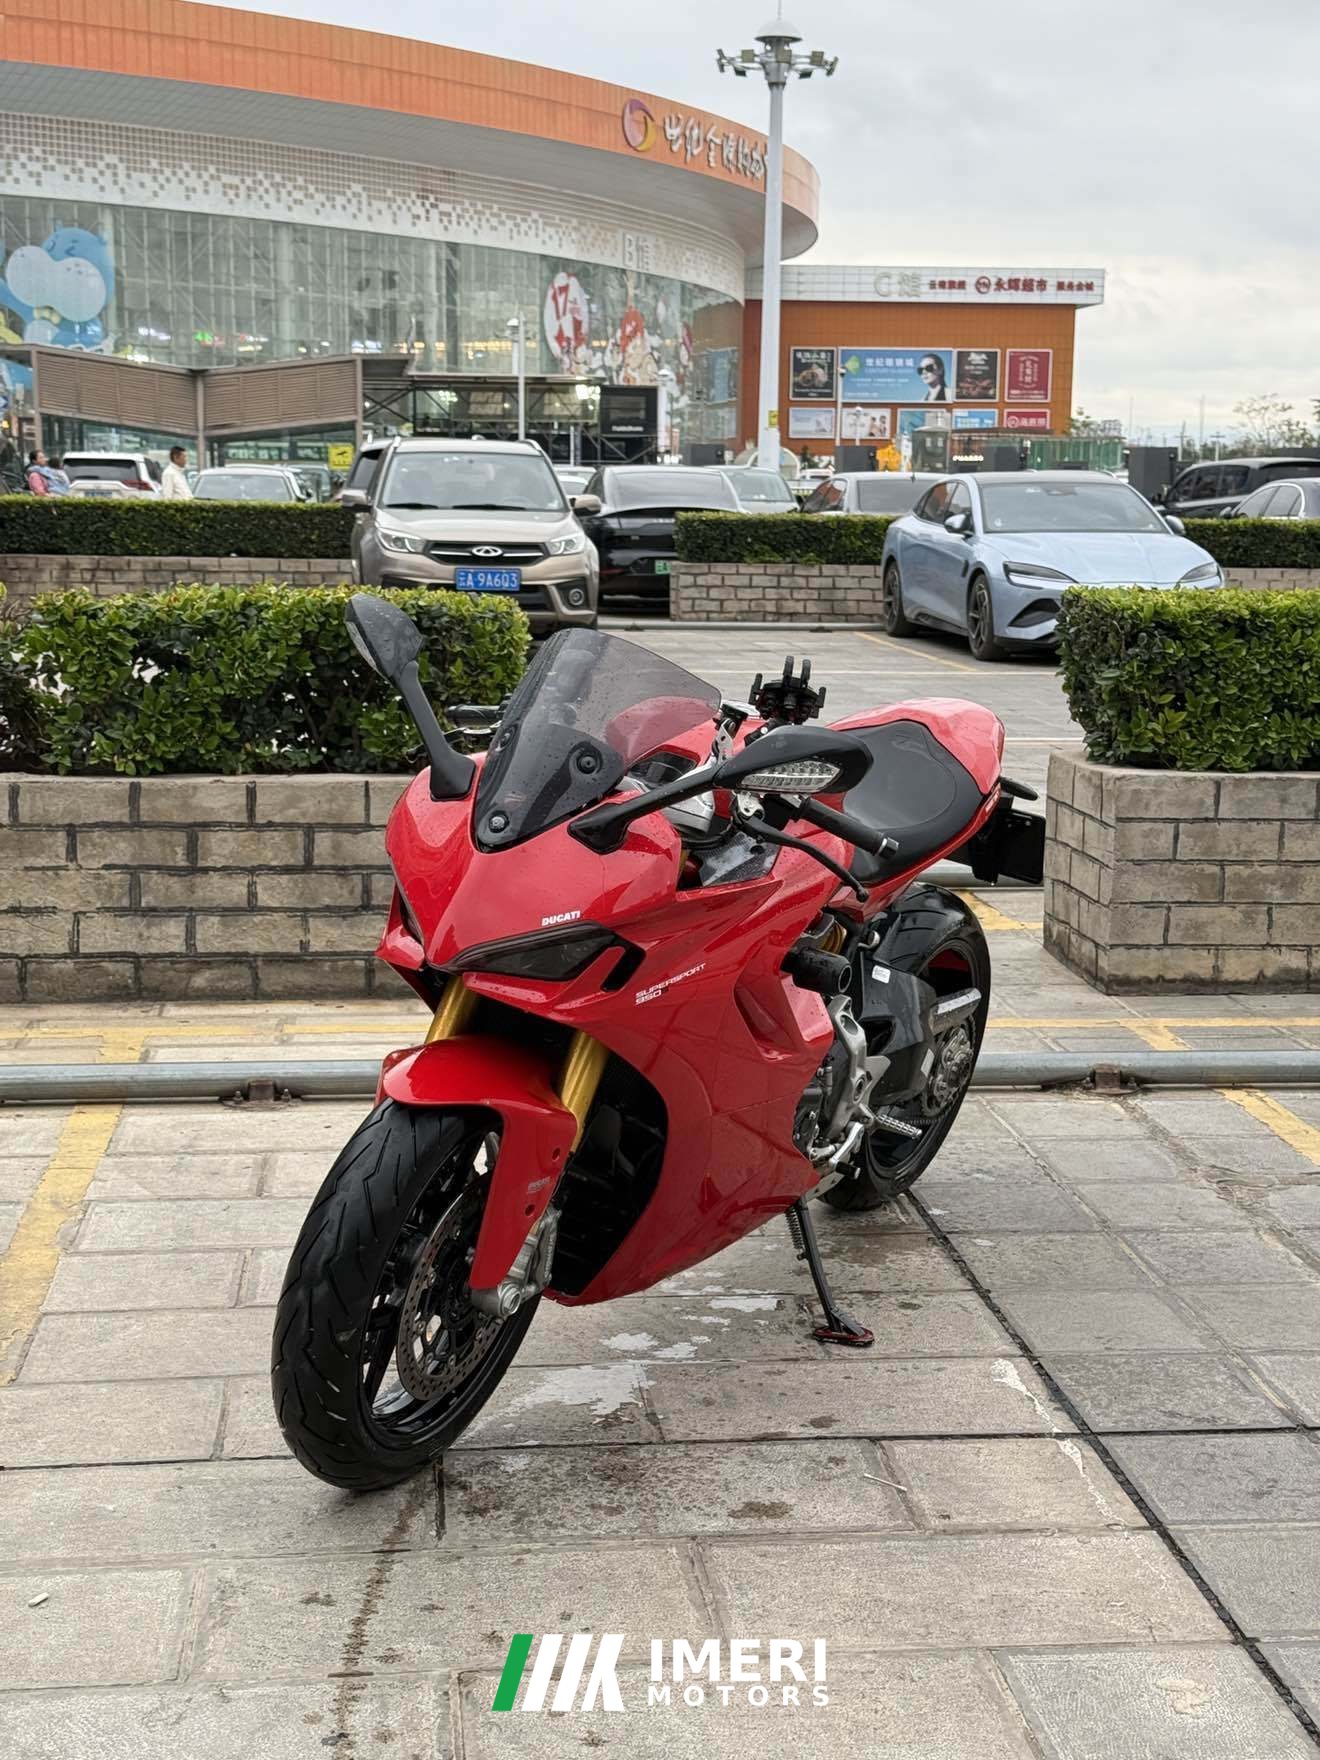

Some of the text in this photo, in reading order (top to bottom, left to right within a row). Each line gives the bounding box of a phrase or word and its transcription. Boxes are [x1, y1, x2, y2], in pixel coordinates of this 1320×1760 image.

[541, 910, 581, 926] DUCATI
[635, 963, 706, 997] SUPERSPORT
[635, 989, 663, 1006] 950
